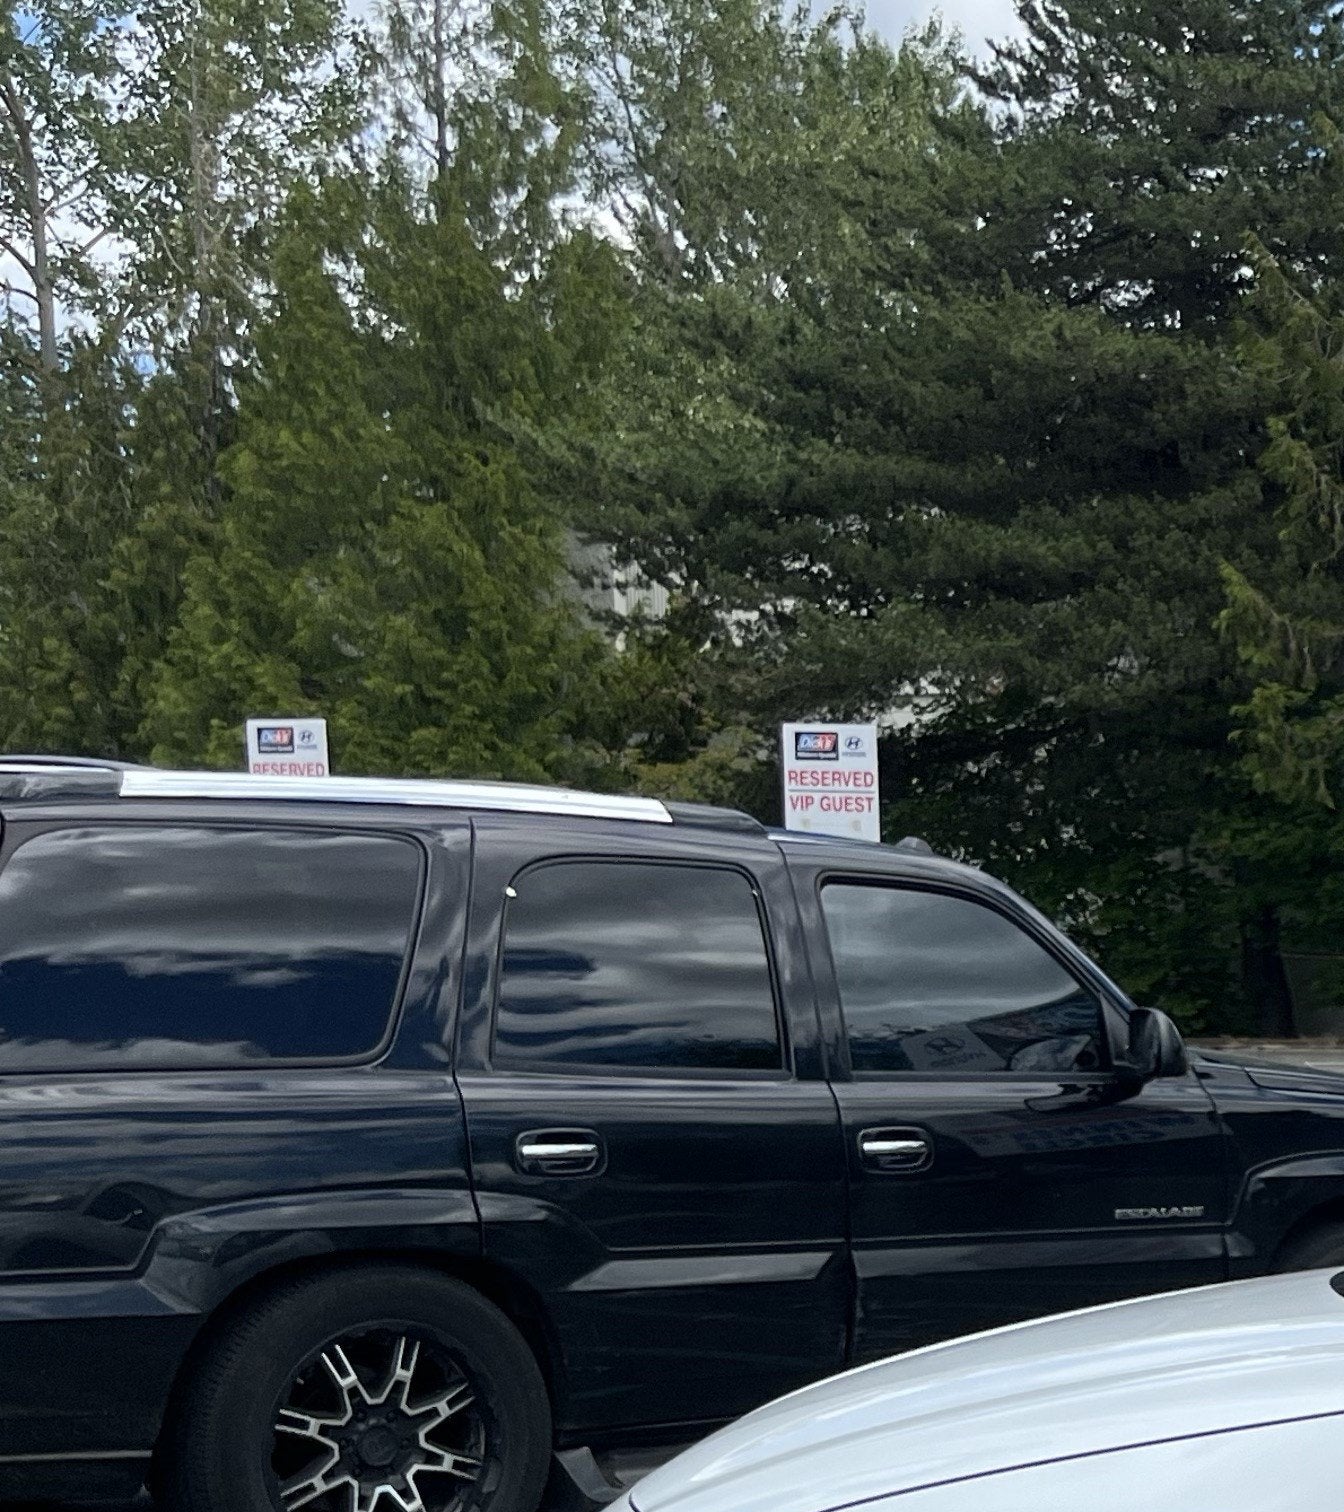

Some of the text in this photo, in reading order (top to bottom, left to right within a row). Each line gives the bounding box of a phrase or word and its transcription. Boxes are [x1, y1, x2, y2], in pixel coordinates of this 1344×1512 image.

[252, 762, 325, 777] RESERVED
[788, 770, 874, 787] RESERVED
[789, 795, 874, 813] VIP GUEST
